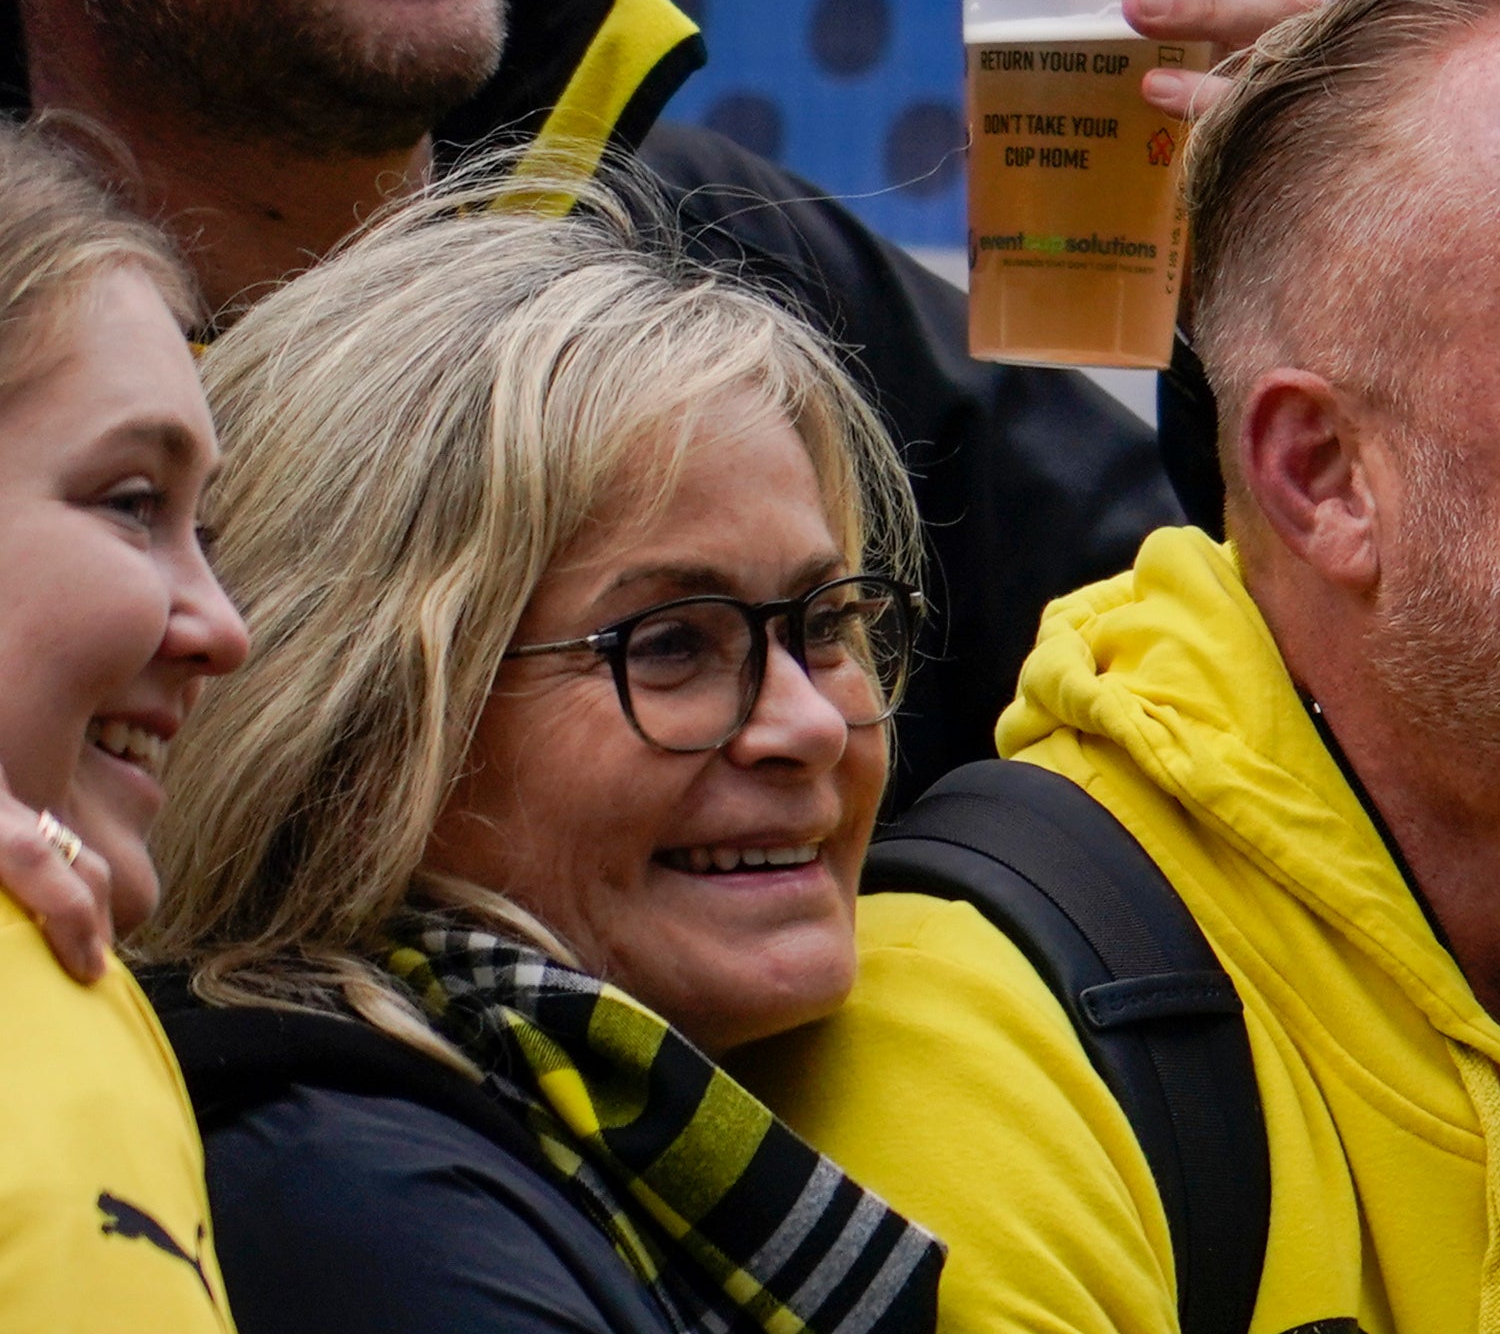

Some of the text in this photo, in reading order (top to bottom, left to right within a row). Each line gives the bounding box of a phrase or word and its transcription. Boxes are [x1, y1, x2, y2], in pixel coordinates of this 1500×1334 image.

[980, 50, 1130, 76] RETURN YOUR CUP
[983, 114, 1119, 140] DON'T TAKE YOUR
[1004, 146, 1090, 170] CUP HOME
